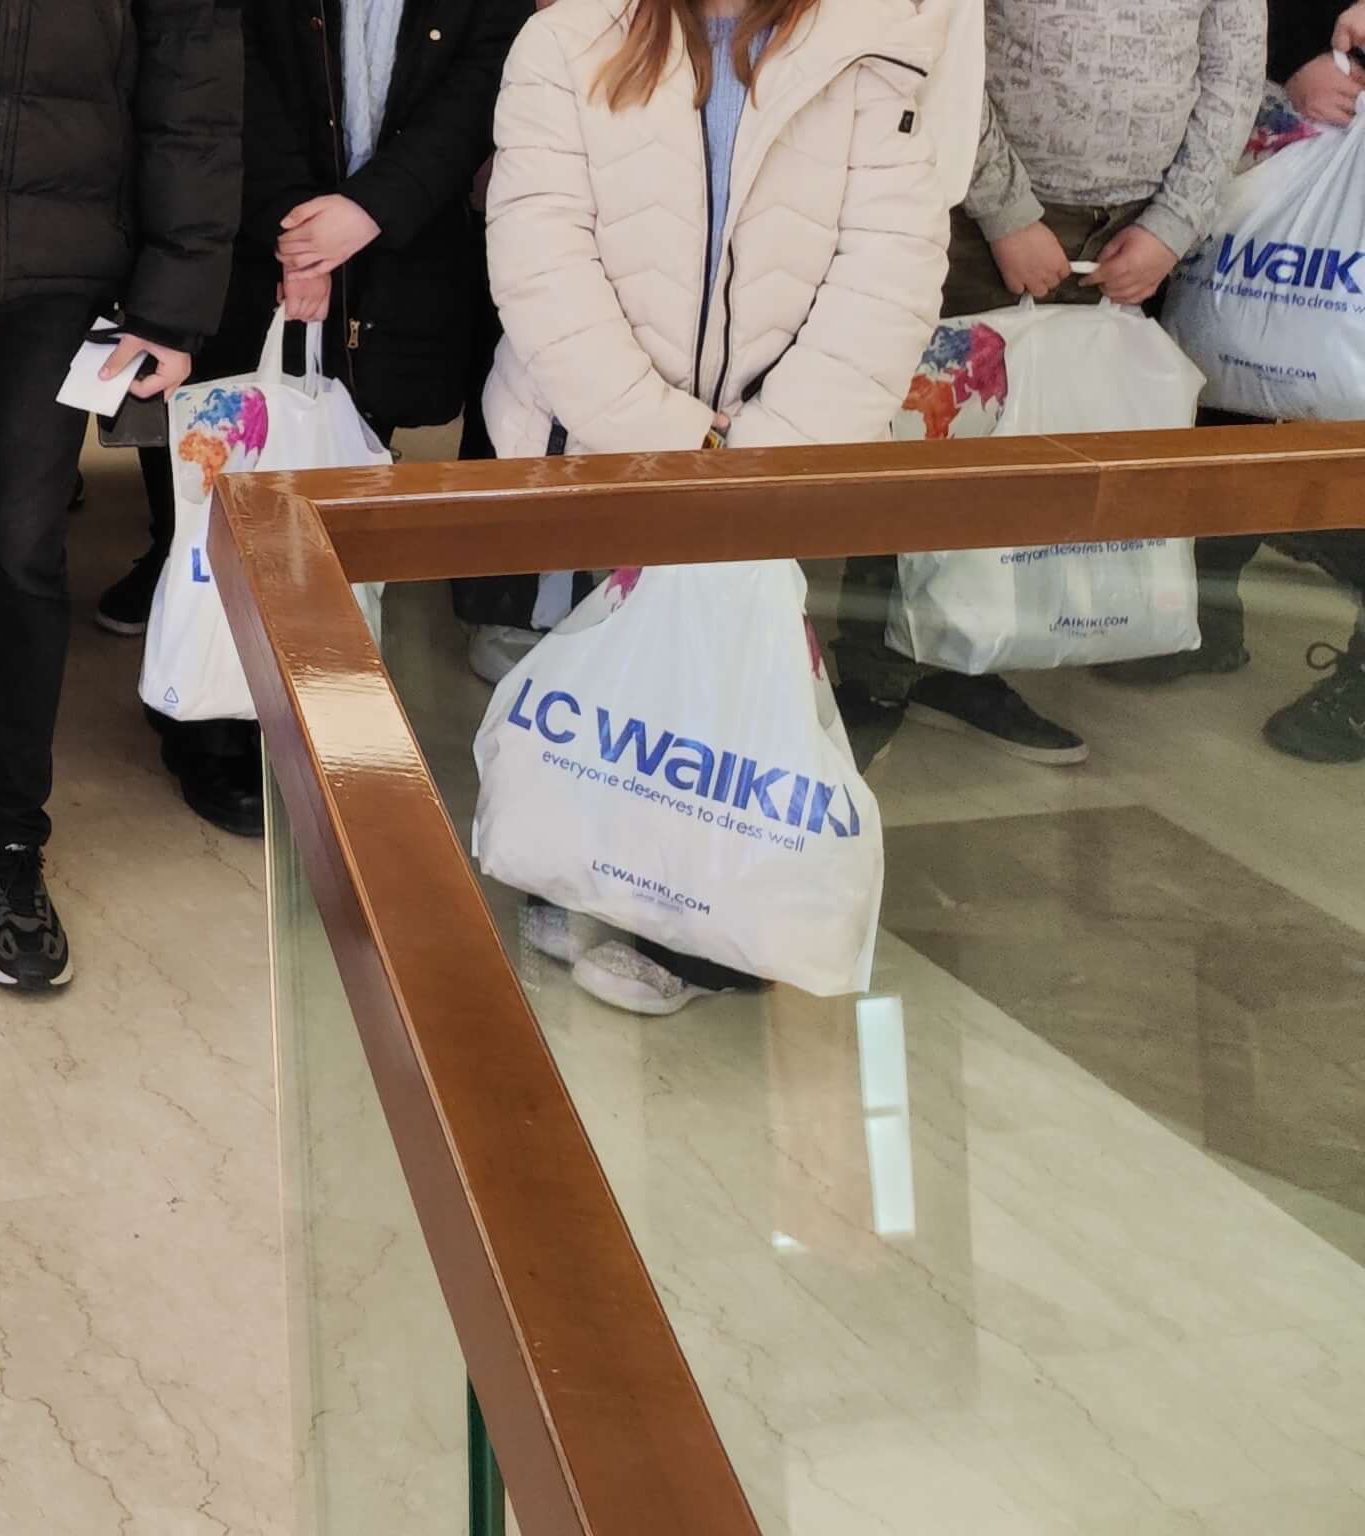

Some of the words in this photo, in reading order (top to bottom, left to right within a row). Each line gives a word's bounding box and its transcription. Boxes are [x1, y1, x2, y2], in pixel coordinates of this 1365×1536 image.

[508, 678, 581, 745] LC
[542, 750, 620, 788] everyone
[622, 776, 693, 817] deserves
[697, 806, 715, 824] to
[717, 813, 763, 841] dress
[768, 830, 805, 854] well
[592, 860, 712, 916] LCWAIKIKI.COM
